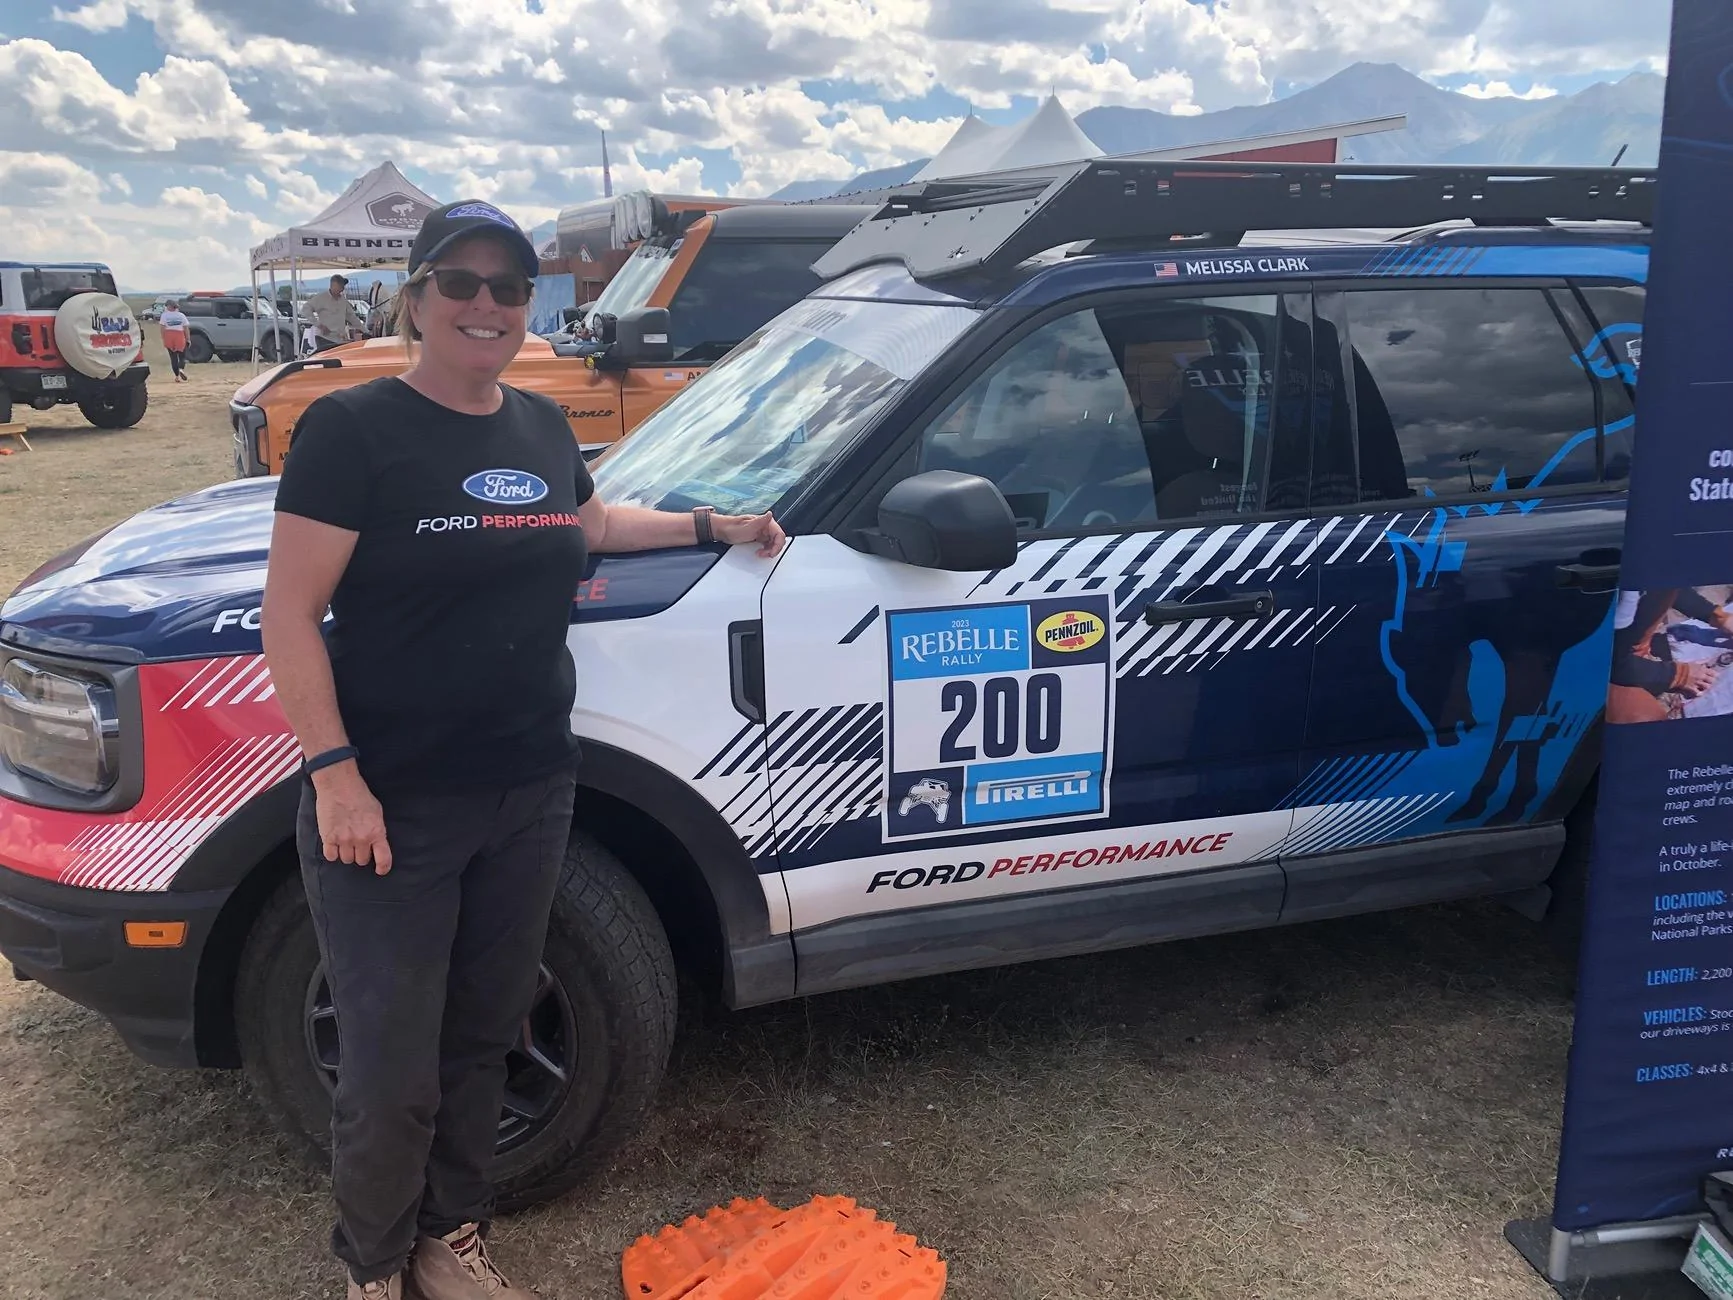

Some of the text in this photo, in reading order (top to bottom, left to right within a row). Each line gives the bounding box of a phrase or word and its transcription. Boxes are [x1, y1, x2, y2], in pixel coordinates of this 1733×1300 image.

[1186, 257, 1309, 275] MELISSA CLARK
[560, 405, 615, 417] Bronco
[1709, 449, 1733, 468] co
[484, 474, 534, 498] Ford
[416, 513, 583, 534] FORD PERFORMAN
[952, 619, 970, 628] 2023
[1045, 620, 1096, 642] PENNZOIL
[902, 628, 1020, 663] REBELLE
[942, 653, 983, 667] RALLY
[939, 672, 1062, 764] 200
[1668, 768, 1690, 780] The
[975, 769, 1093, 805] PIRELLI
[1666, 780, 1723, 796] extremely
[1664, 800, 1690, 812] map
[1693, 796, 1716, 808] and
[1662, 814, 1698, 826] crews.
[1658, 846, 1668, 857] A
[1670, 843, 1698, 857] truly
[1700, 844, 1708, 853] a
[866, 832, 1233, 894] FORD PERFORMANCE
[1659, 858, 1722, 872] in October.
[1655, 890, 1727, 911] LOCATIONS:
[1653, 912, 1704, 926] including
[1706, 910, 1725, 921] the
[1651, 924, 1733, 941] National Parks
[1647, 967, 1732, 986] LENGTH: 2,200
[1644, 1006, 1707, 1026] VEHICLES:
[1640, 1021, 1731, 1040] our driveways is
[1636, 1063, 1693, 1082] CLASSES:
[1696, 1064, 1718, 1075] 4x4
